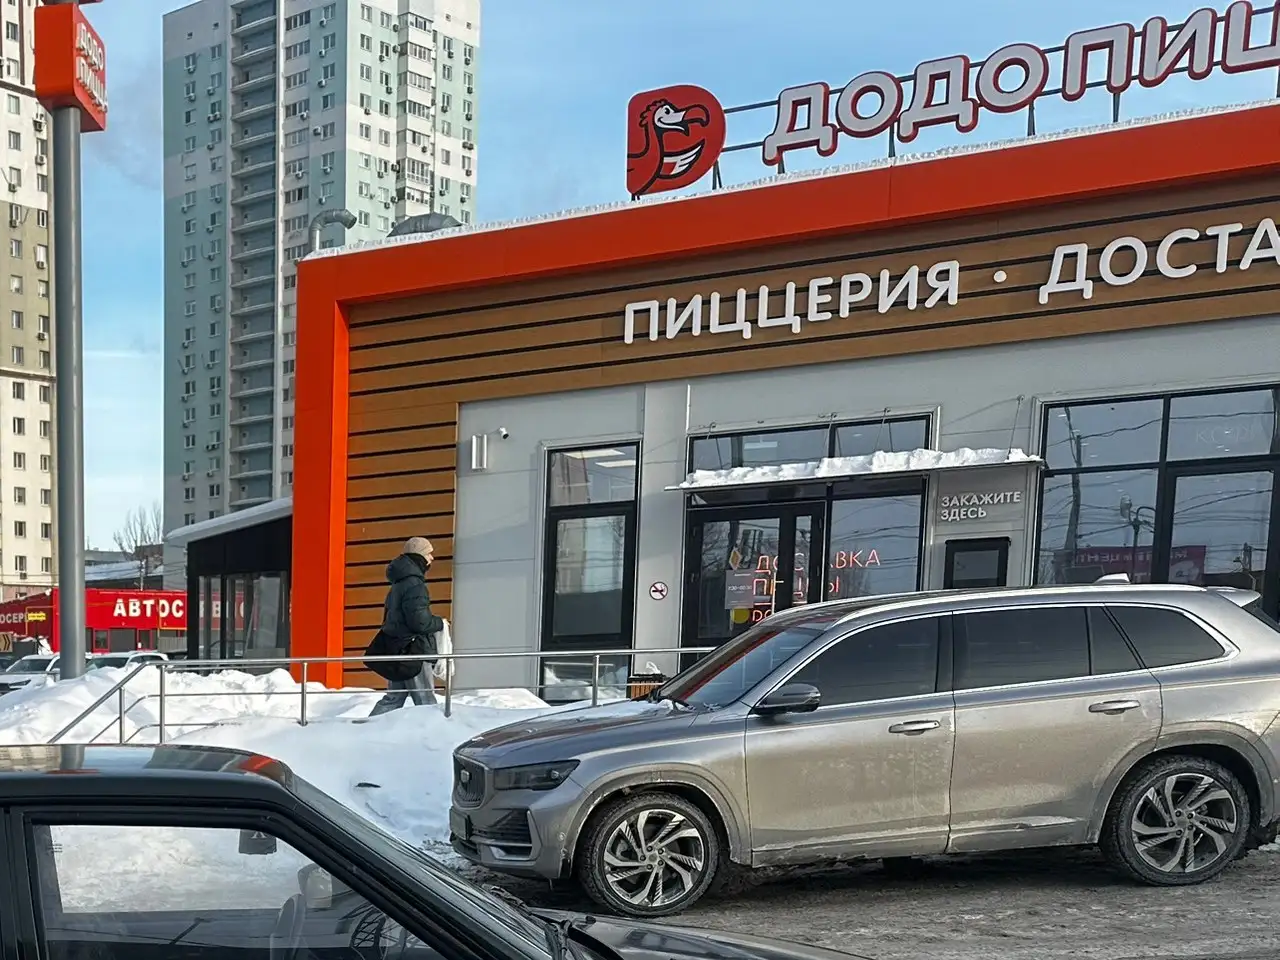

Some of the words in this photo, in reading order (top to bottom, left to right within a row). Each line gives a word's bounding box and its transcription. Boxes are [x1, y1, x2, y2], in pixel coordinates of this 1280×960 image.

[762, 43, 1050, 166] ДОДО
[624, 260, 961, 345] ПИЦЦЕРИЯ
[1039, 217, 1280, 306] ДОСТА
[941, 491, 1021, 507] ЗАКАЖИТЕ
[940, 506, 987, 521] ЗДЕСЬ
[113, 598, 184, 618] АВТОС
